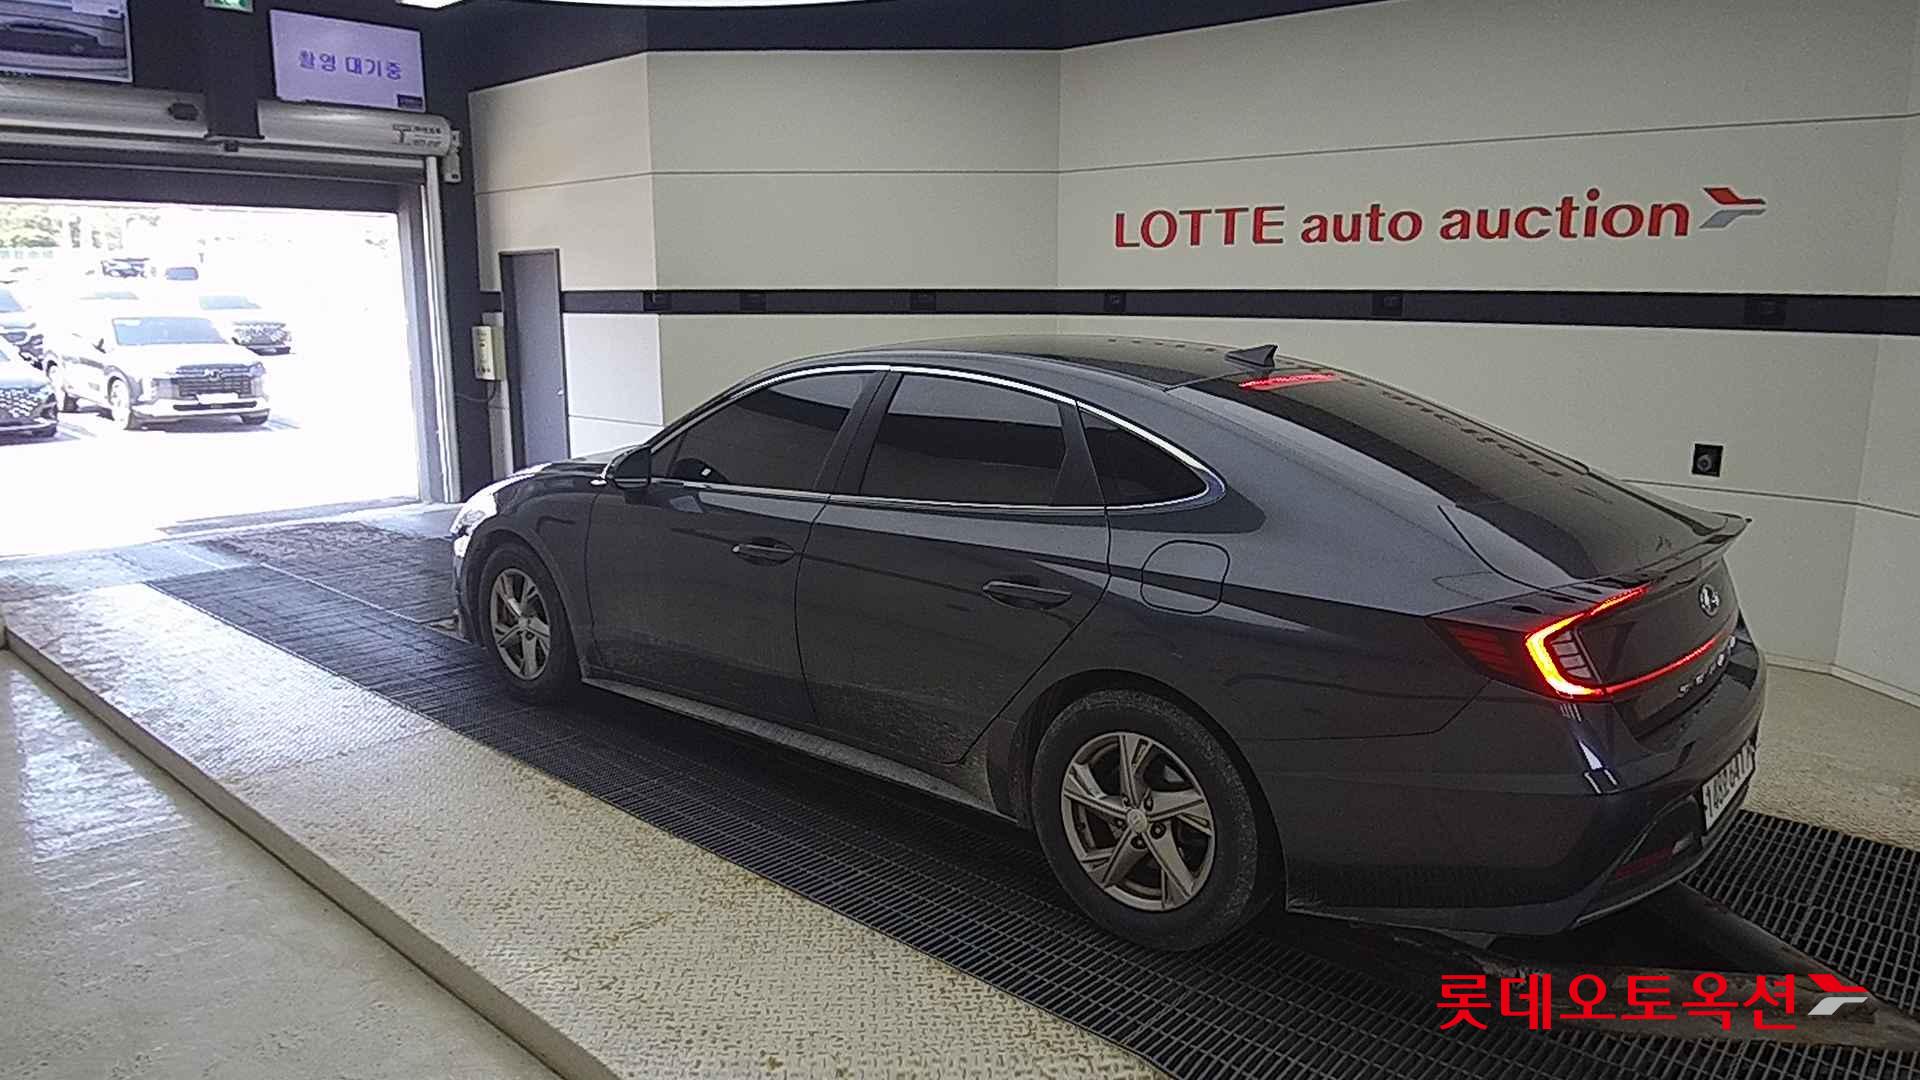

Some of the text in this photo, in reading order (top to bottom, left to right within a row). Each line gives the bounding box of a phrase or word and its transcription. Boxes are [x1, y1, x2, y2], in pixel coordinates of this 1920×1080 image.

[345, 57, 401, 80] 대기중
[1115, 189, 1690, 249] LOTTE auto auction
